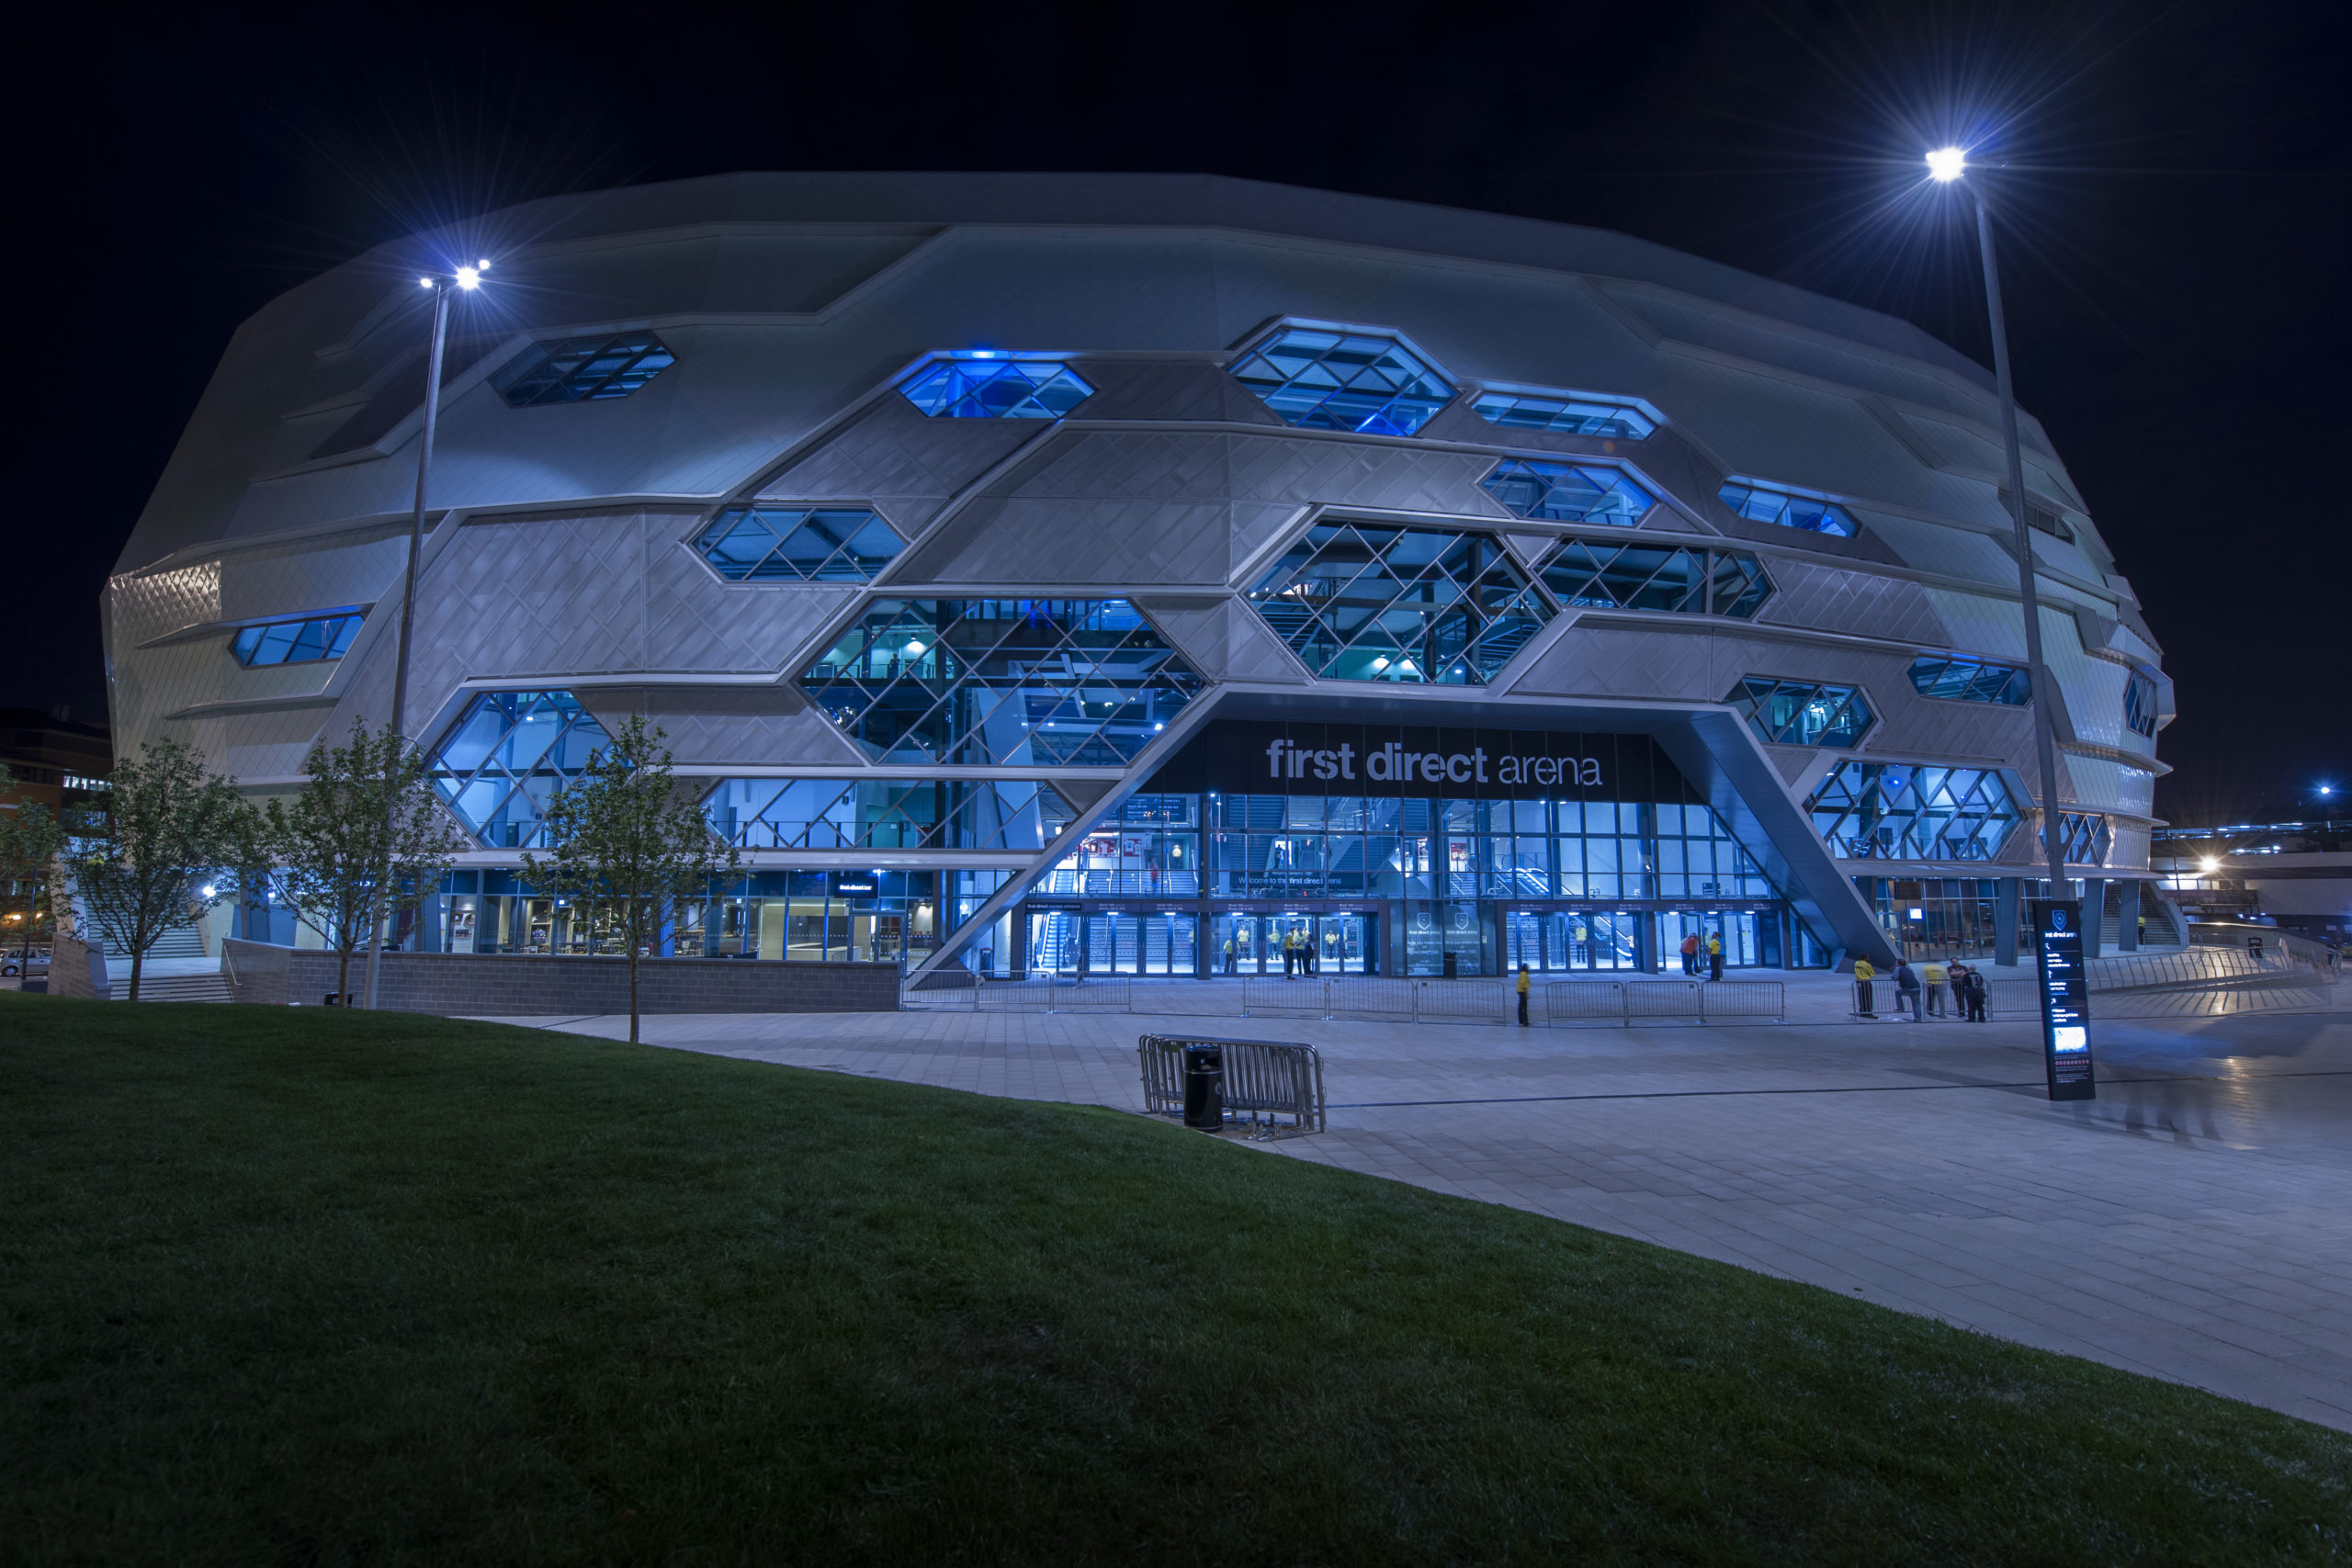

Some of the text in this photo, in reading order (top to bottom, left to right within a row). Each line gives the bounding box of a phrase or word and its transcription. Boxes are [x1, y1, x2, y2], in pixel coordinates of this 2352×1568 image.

[1266, 739, 1603, 785] first direct arena
[1289, 876, 1303, 885] first
[1304, 876, 1324, 885] direct
